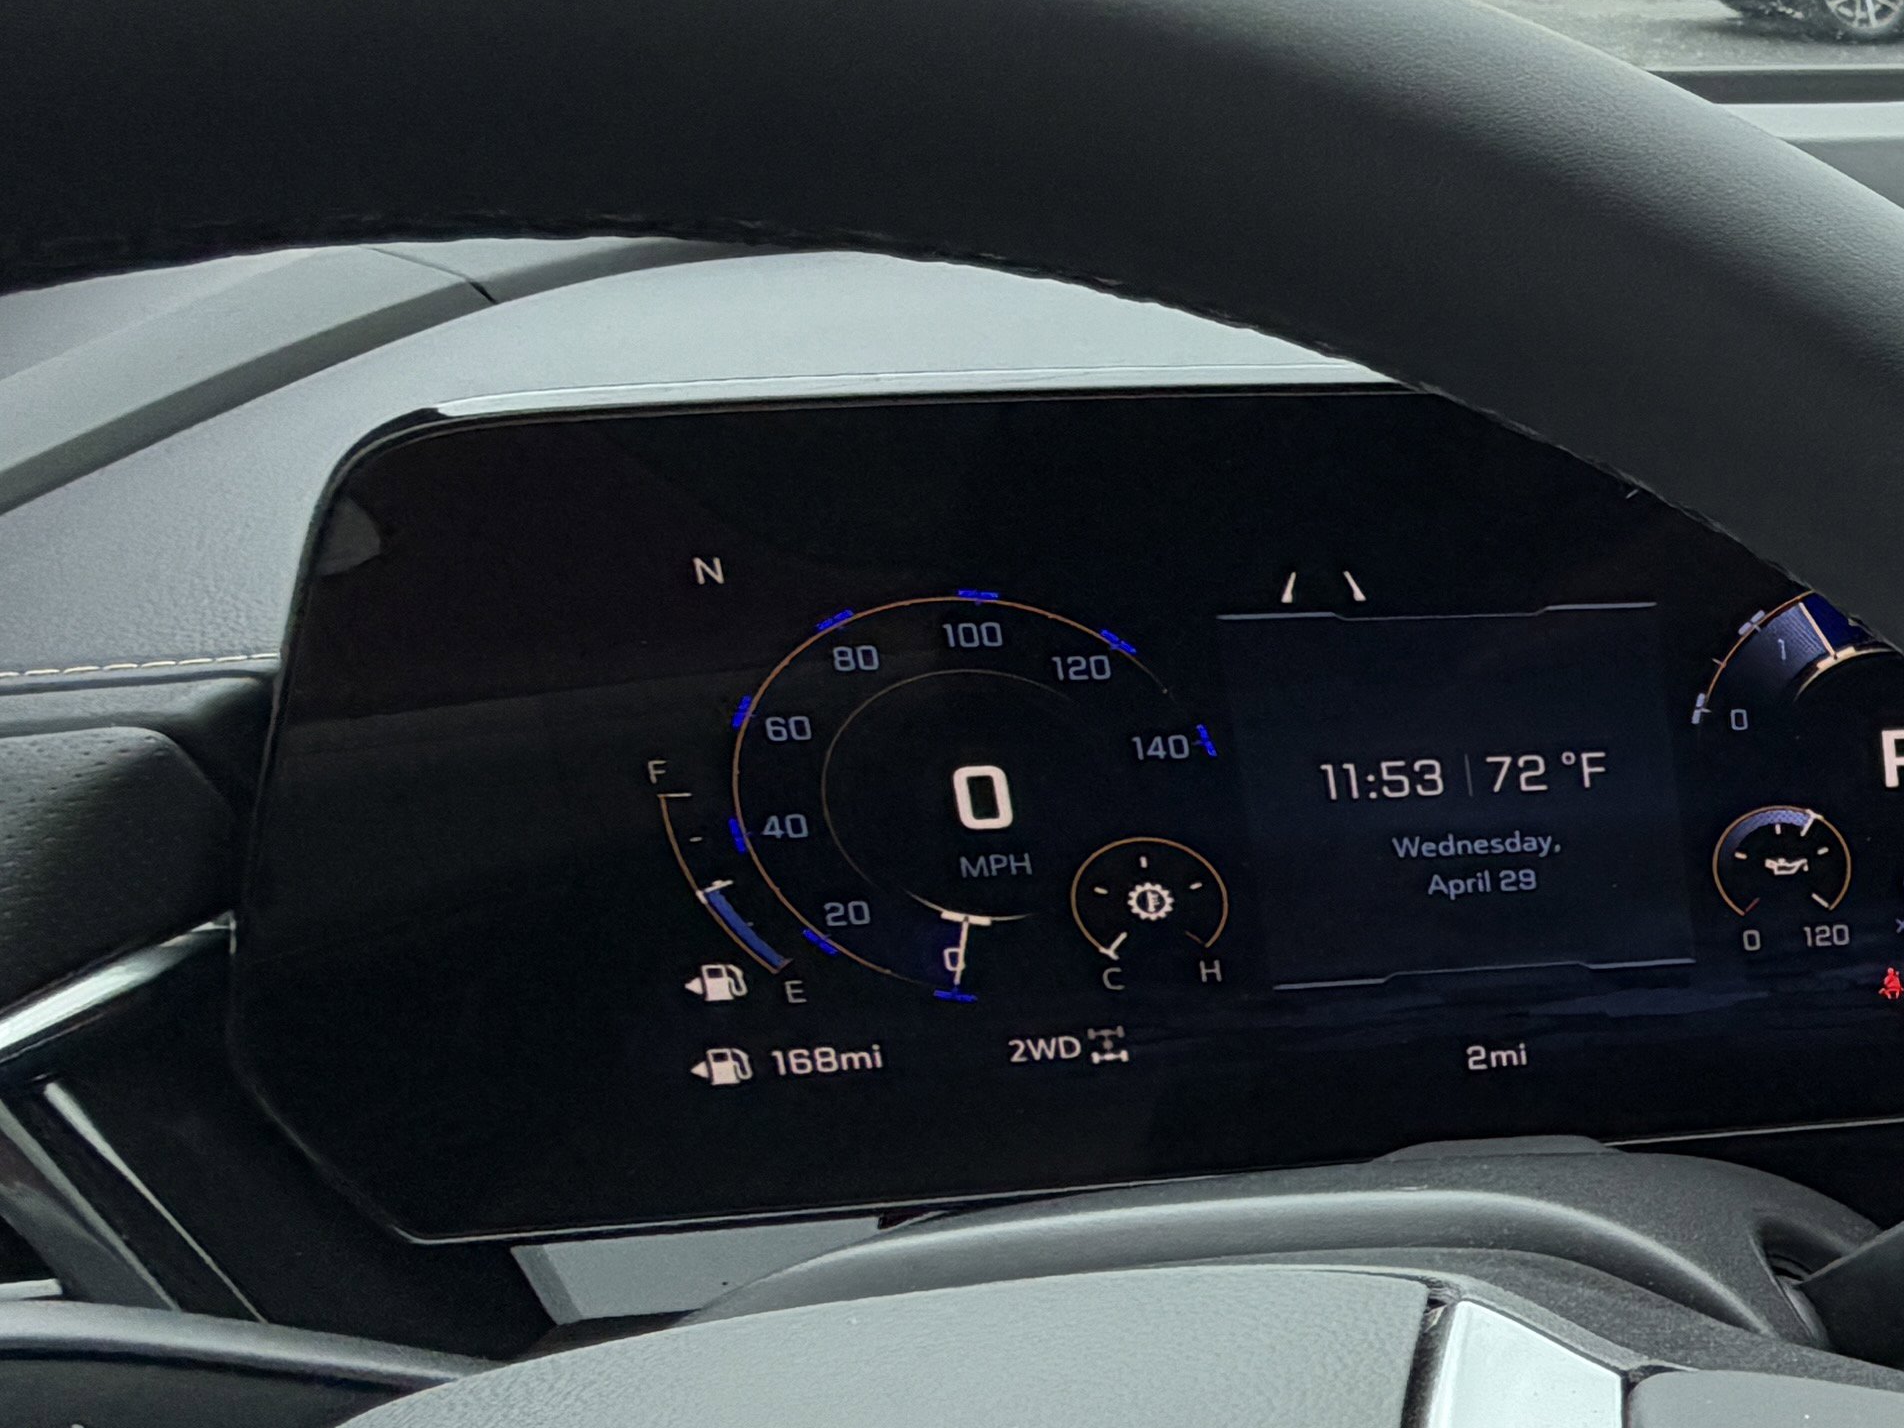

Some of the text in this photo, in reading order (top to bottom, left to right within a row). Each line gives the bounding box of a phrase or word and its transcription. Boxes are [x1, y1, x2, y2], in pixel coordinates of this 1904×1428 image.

[693, 557, 724, 585] N
[942, 621, 1003, 648] 100
[832, 645, 880, 672] 80
[1051, 654, 1112, 681] 120
[765, 715, 812, 742] 60
[1730, 708, 1749, 731] 0
[1132, 734, 1190, 761] 140
[647, 759, 667, 784] F
[1320, 759, 1444, 800] 11:53
[1485, 754, 1548, 793] 72
[952, 765, 1013, 830] 0
[762, 813, 809, 839] 40
[1391, 830, 1561, 858] Wednesday,
[959, 852, 1033, 878] MPH
[1427, 868, 1537, 901] April 29
[823, 900, 871, 927] 20
[1742, 929, 1761, 951] 0
[1803, 924, 1850, 947] 120
[1102, 967, 1125, 991] C
[1199, 959, 1222, 983] H
[784, 979, 807, 1004] E
[771, 1044, 882, 1076] 168mi
[1008, 1035, 1082, 1063] 2WD
[1466, 1043, 1527, 1070] 2mi
